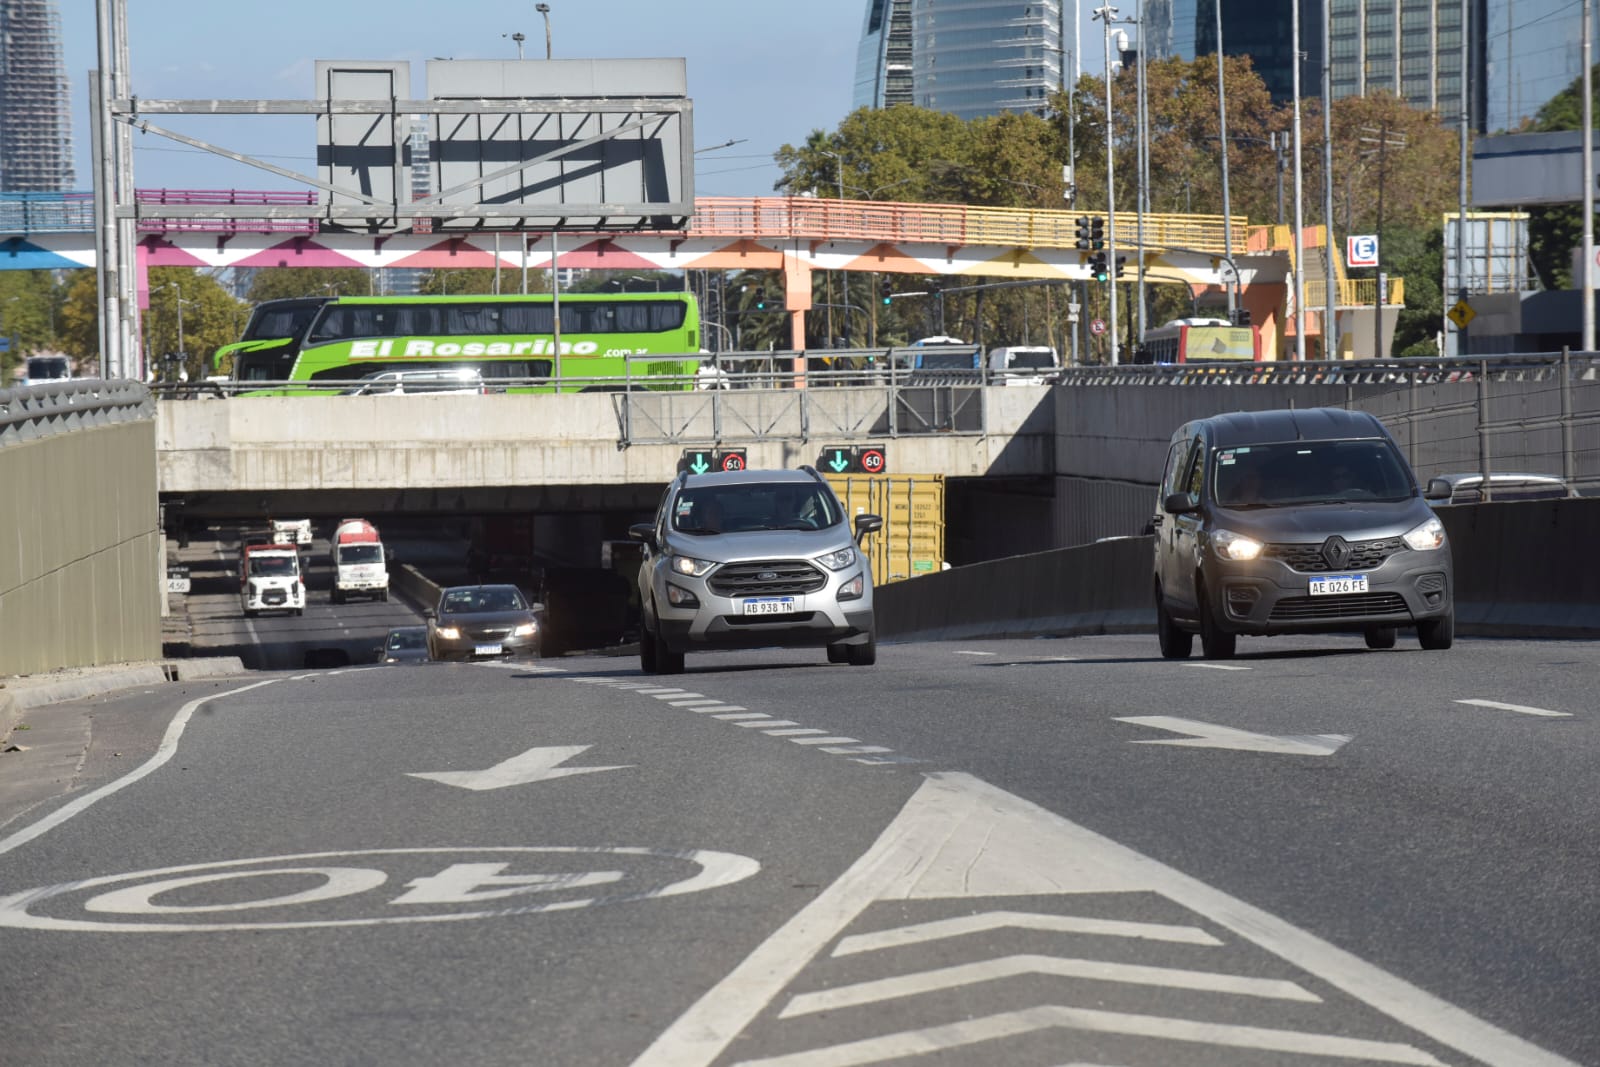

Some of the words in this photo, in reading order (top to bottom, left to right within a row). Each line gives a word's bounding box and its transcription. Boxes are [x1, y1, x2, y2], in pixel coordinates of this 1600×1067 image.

[1358, 239, 1374, 257] E
[350, 340, 393, 357] El
[404, 338, 598, 356] Rosarino
[603, 347, 648, 358] .comar
[726, 459, 741, 470] 60
[866, 456, 880, 466] 60
[1312, 582, 1326, 593] AE
[1329, 581, 1349, 592] 026
[1352, 580, 1366, 591] FE
[746, 604, 758, 613] AB
[760, 603, 778, 612] 938
[781, 602, 792, 611] TN
